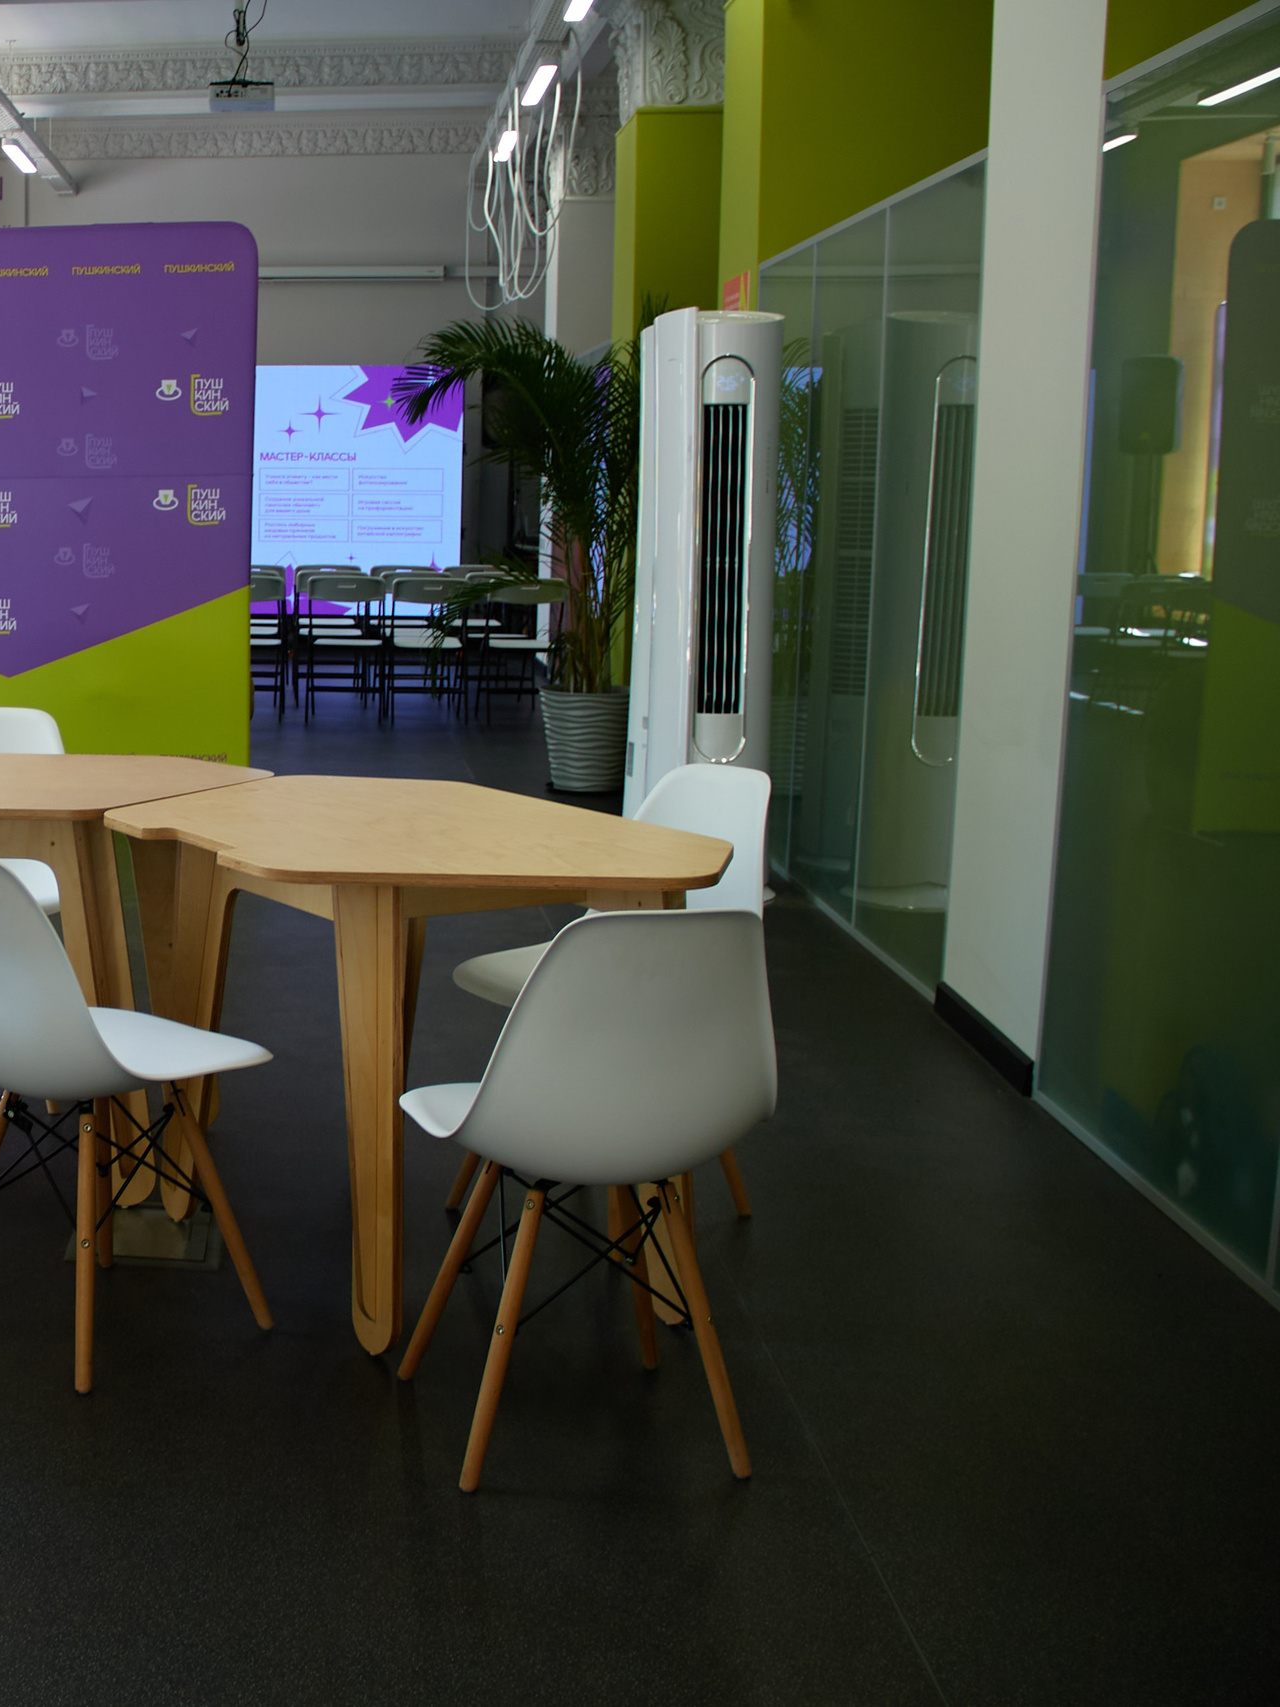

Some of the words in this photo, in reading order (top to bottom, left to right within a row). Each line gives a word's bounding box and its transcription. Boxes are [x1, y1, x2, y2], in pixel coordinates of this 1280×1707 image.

[72, 264, 141, 275] ПУШКИНСКИЙ
[164, 262, 235, 273] ПУШКИНСКИЙ
[195, 378, 223, 389] ПУШ
[195, 390, 221, 400] КИН
[195, 398, 228, 412] СКИЙ
[260, 452, 357, 461] МАСТЕР-КЛАССЫ
[192, 488, 220, 500] ПУШ
[192, 500, 217, 510] КИН
[192, 507, 226, 521] СКИЙ
